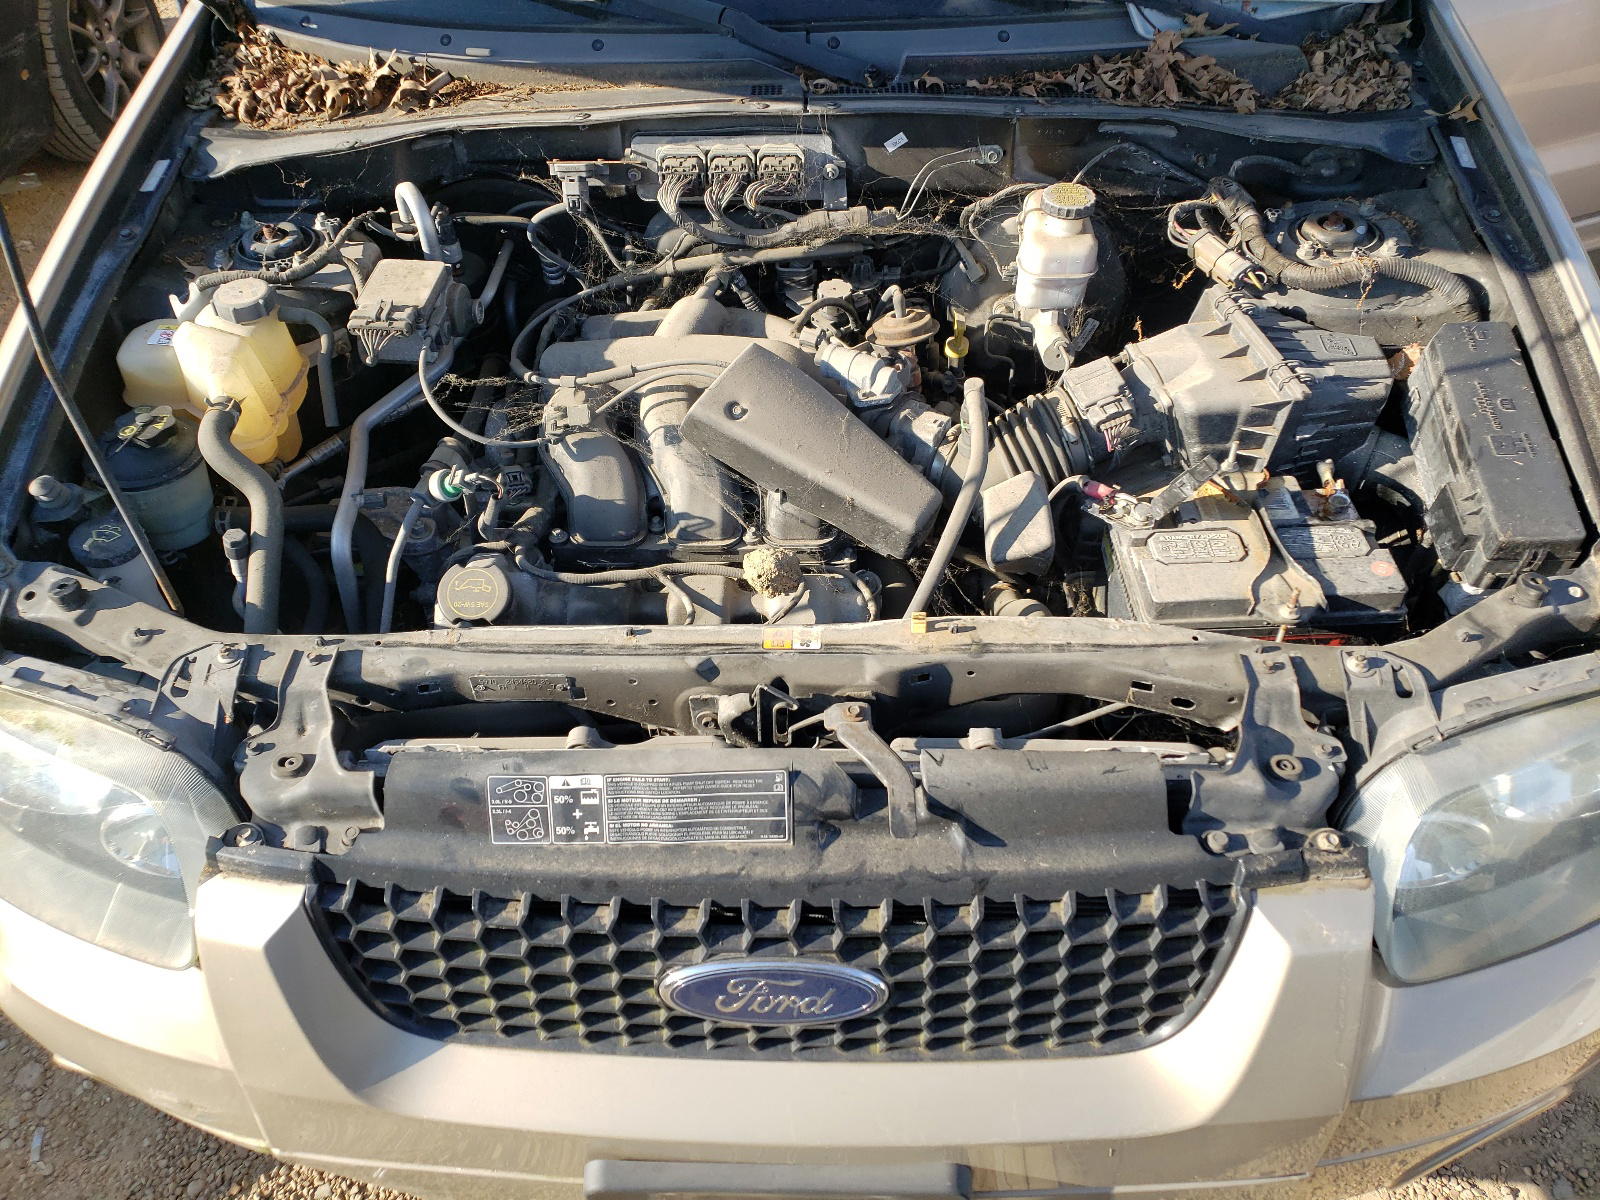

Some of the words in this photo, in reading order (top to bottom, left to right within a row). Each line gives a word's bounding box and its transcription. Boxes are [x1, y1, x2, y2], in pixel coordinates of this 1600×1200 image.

[553, 795, 574, 804] 50%
[555, 826, 576, 835] 50%
[715, 978, 837, 1016] Ford
